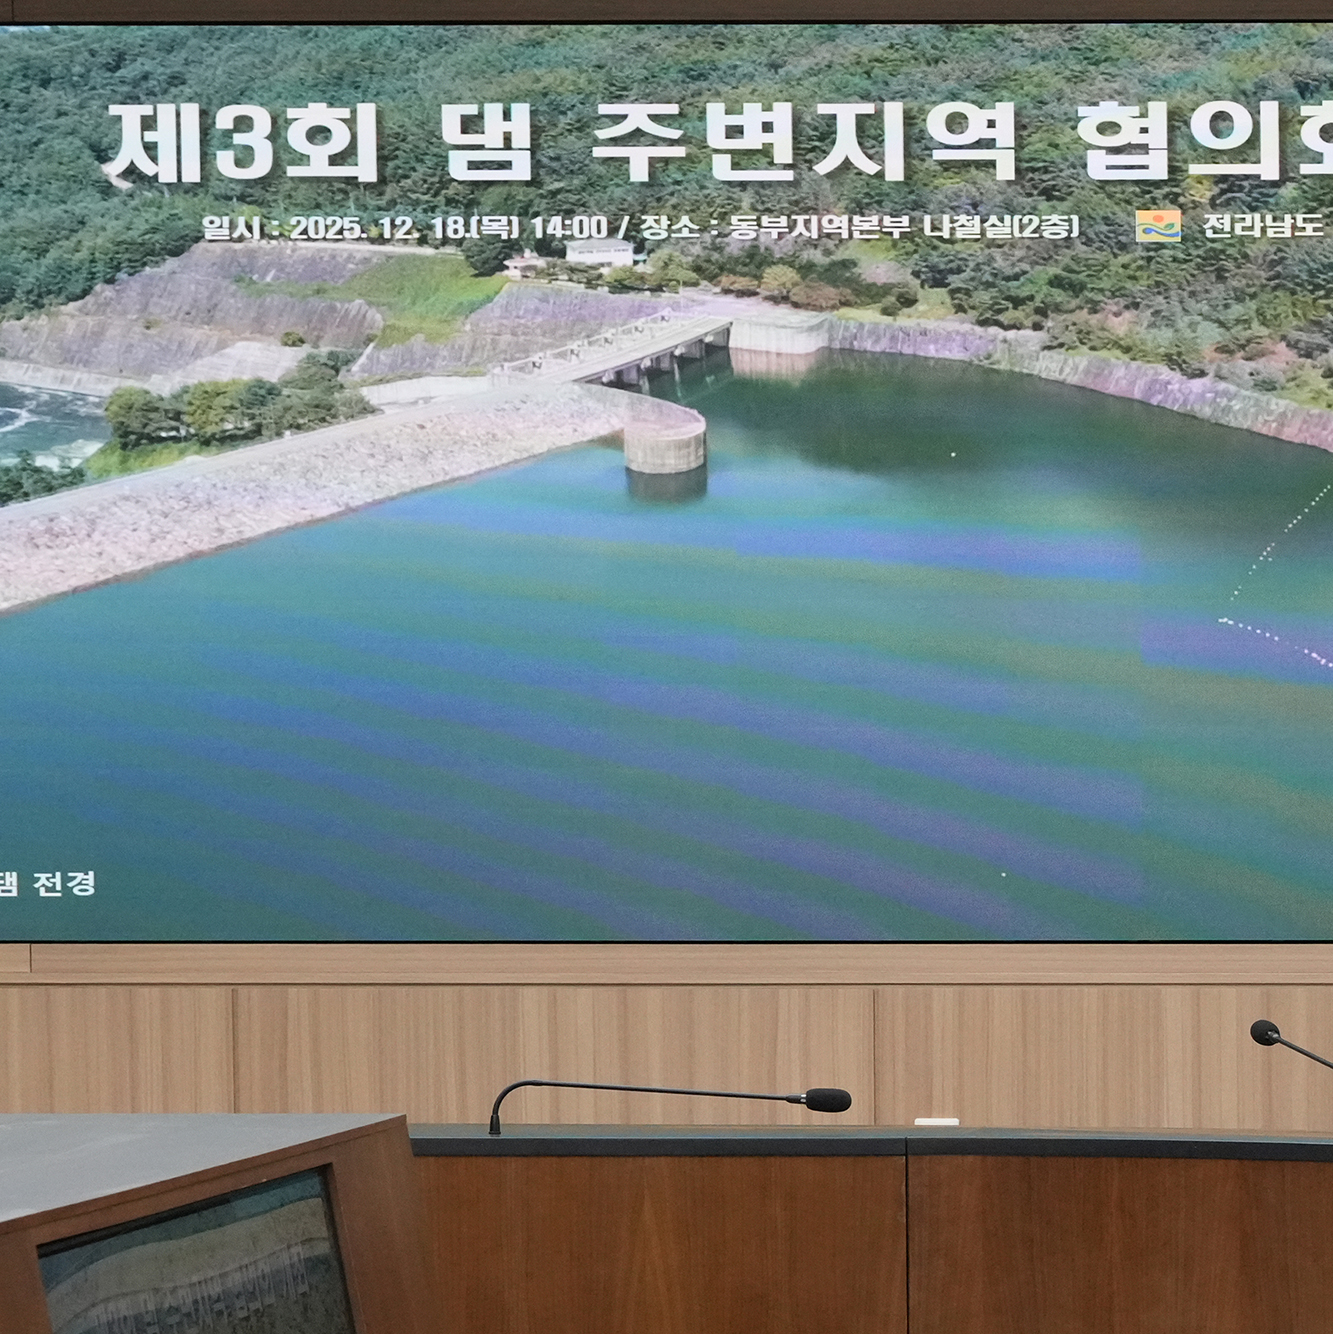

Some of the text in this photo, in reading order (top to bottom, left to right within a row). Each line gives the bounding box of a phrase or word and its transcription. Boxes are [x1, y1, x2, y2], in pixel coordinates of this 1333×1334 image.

[103, 102, 377, 183] 제3회
[442, 103, 530, 182] 댐
[593, 101, 1015, 182] 주변지역
[202, 215, 260, 240] 일시
[290, 216, 368, 239] 2025.
[380, 216, 420, 239] 12.
[531, 215, 608, 239] 14:00
[640, 215, 700, 240] 장소
[729, 214, 911, 240] 동부지역본부
[924, 214, 1079, 240] 나철실(2층)
[1203, 213, 1324, 238] 전라남도
[33, 871, 95, 897] 전경
